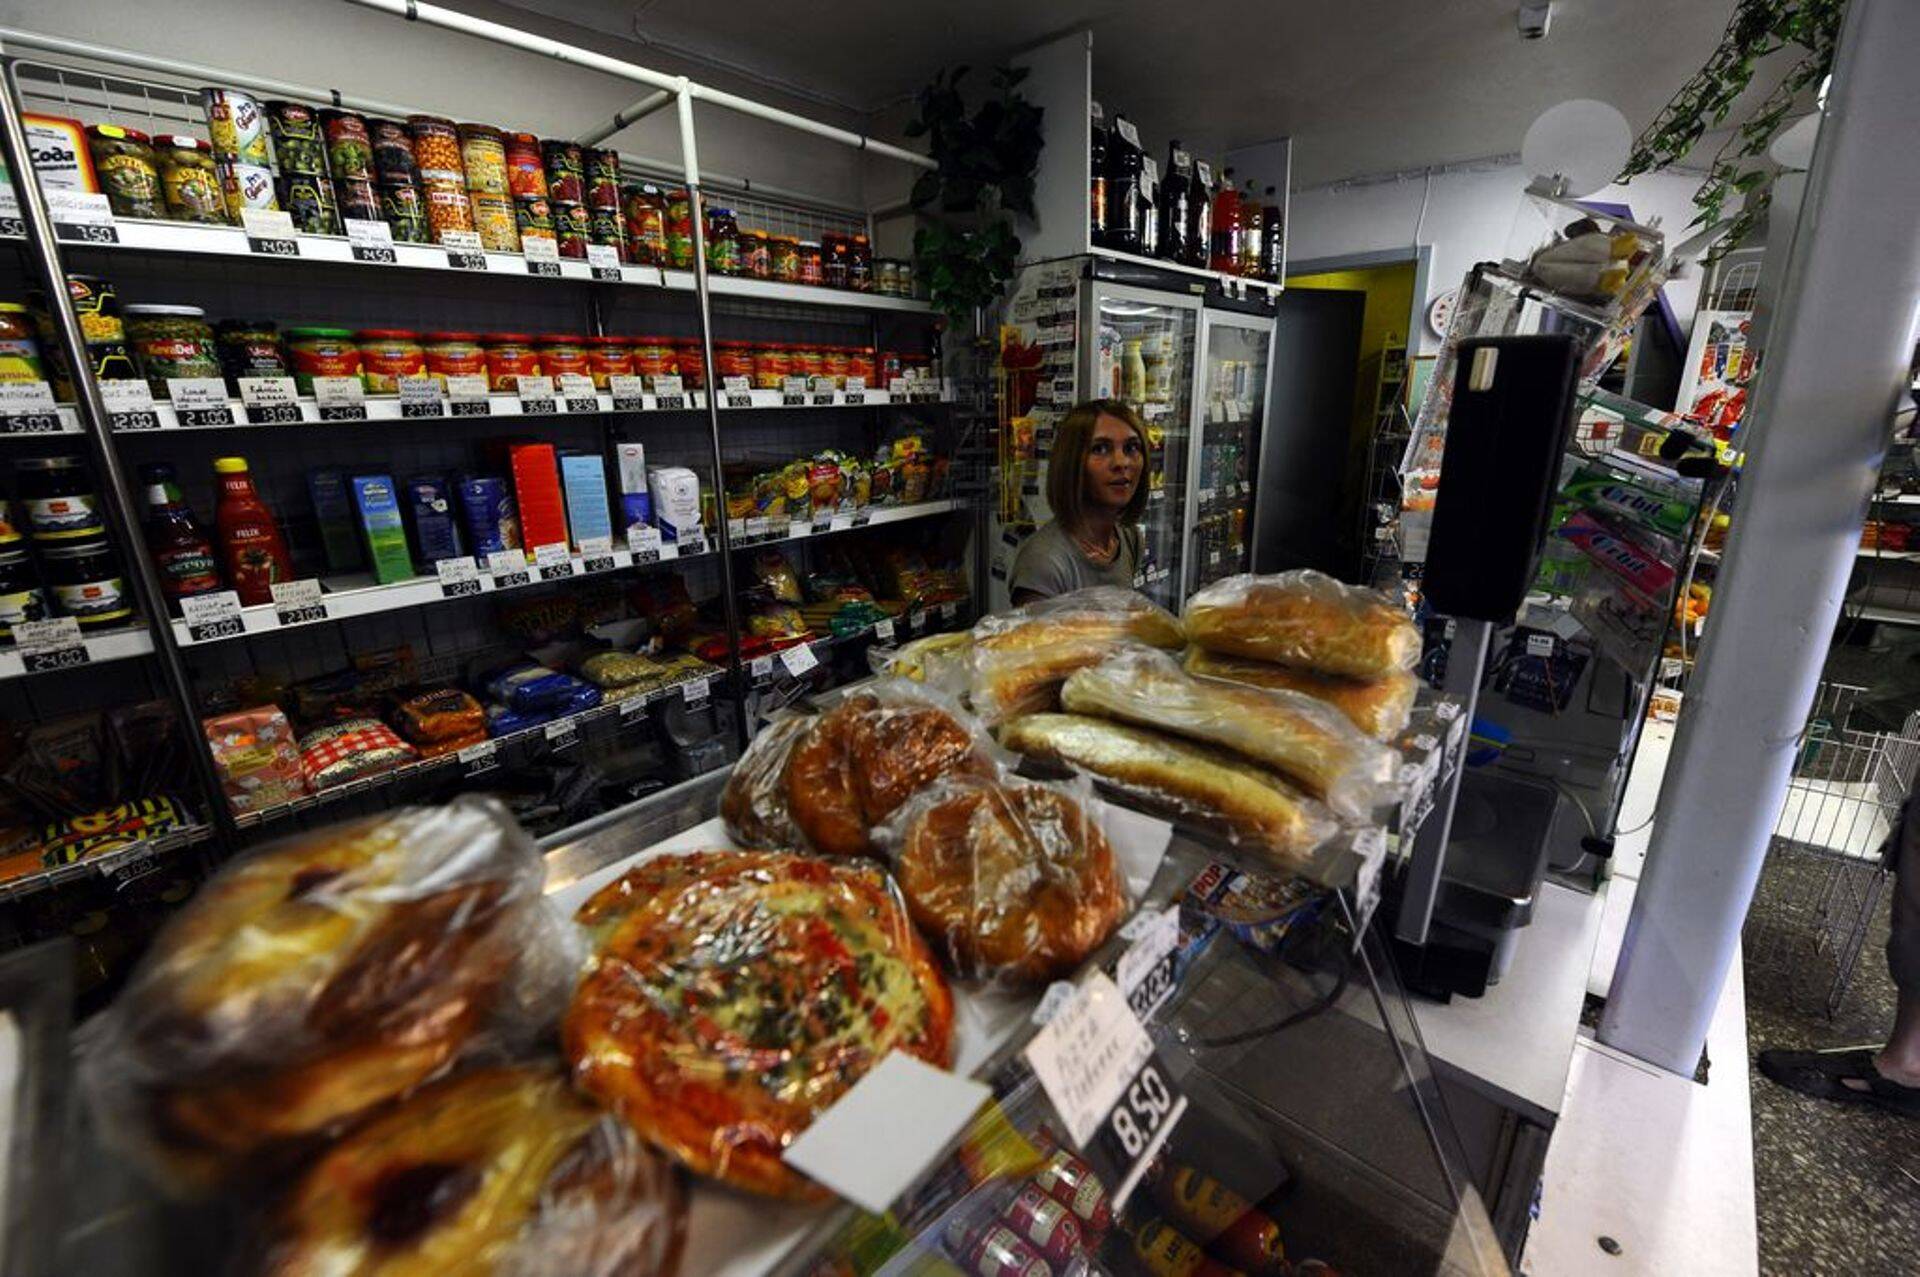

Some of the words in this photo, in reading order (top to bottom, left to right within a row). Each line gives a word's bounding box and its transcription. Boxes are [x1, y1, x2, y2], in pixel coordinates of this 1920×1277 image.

[78, 226, 114, 242] 7.50
[113, 413, 153, 430] 12.00
[186, 410, 229, 426] 21.00
[263, 408, 297, 423] 13.00
[8, 416, 53, 432] 15.00
[226, 480, 249, 491] FELIX
[1602, 484, 1666, 517] Orbit
[235, 528, 261, 539] FELIX
[1591, 534, 1650, 574] Orbit
[1194, 863, 1223, 898] POP
[1111, 1065, 1171, 1158] 8.50
